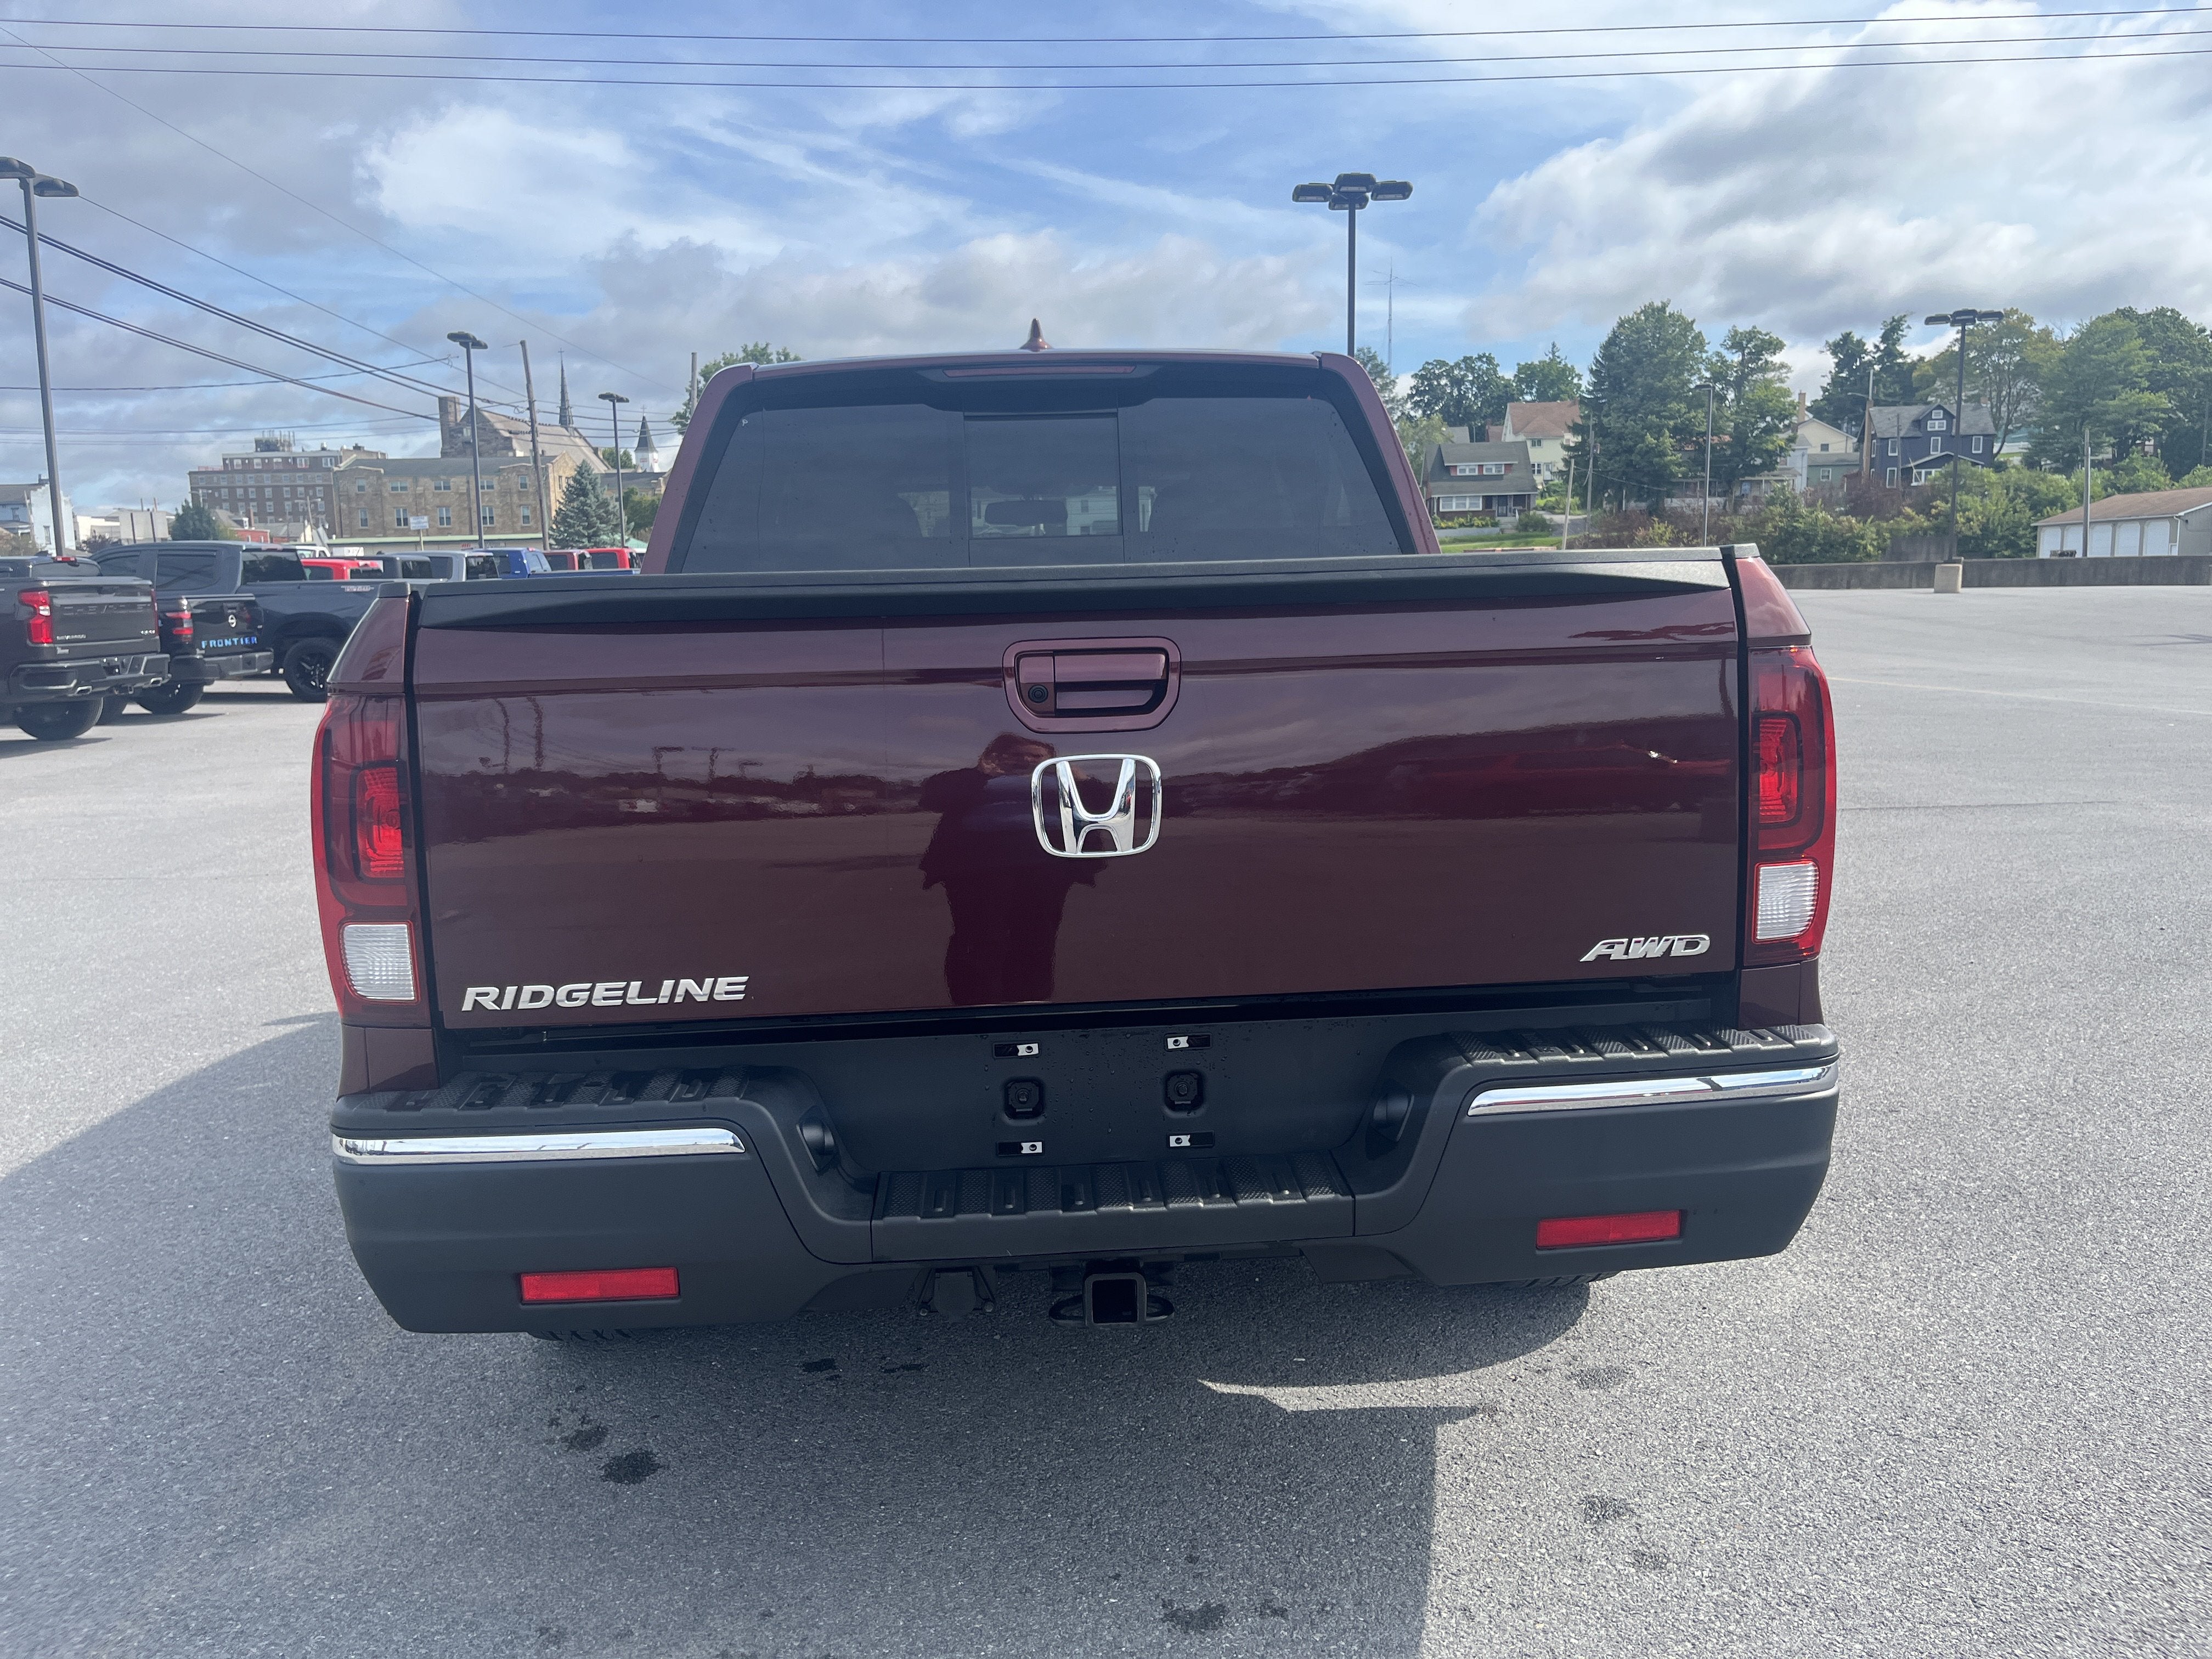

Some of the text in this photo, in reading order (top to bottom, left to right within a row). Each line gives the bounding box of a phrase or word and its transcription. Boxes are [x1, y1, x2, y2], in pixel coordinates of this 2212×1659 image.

[201, 636, 258, 650] FRONTIER
[1579, 934, 1711, 962] AWD
[461, 976, 749, 1011] RIDGELINE
